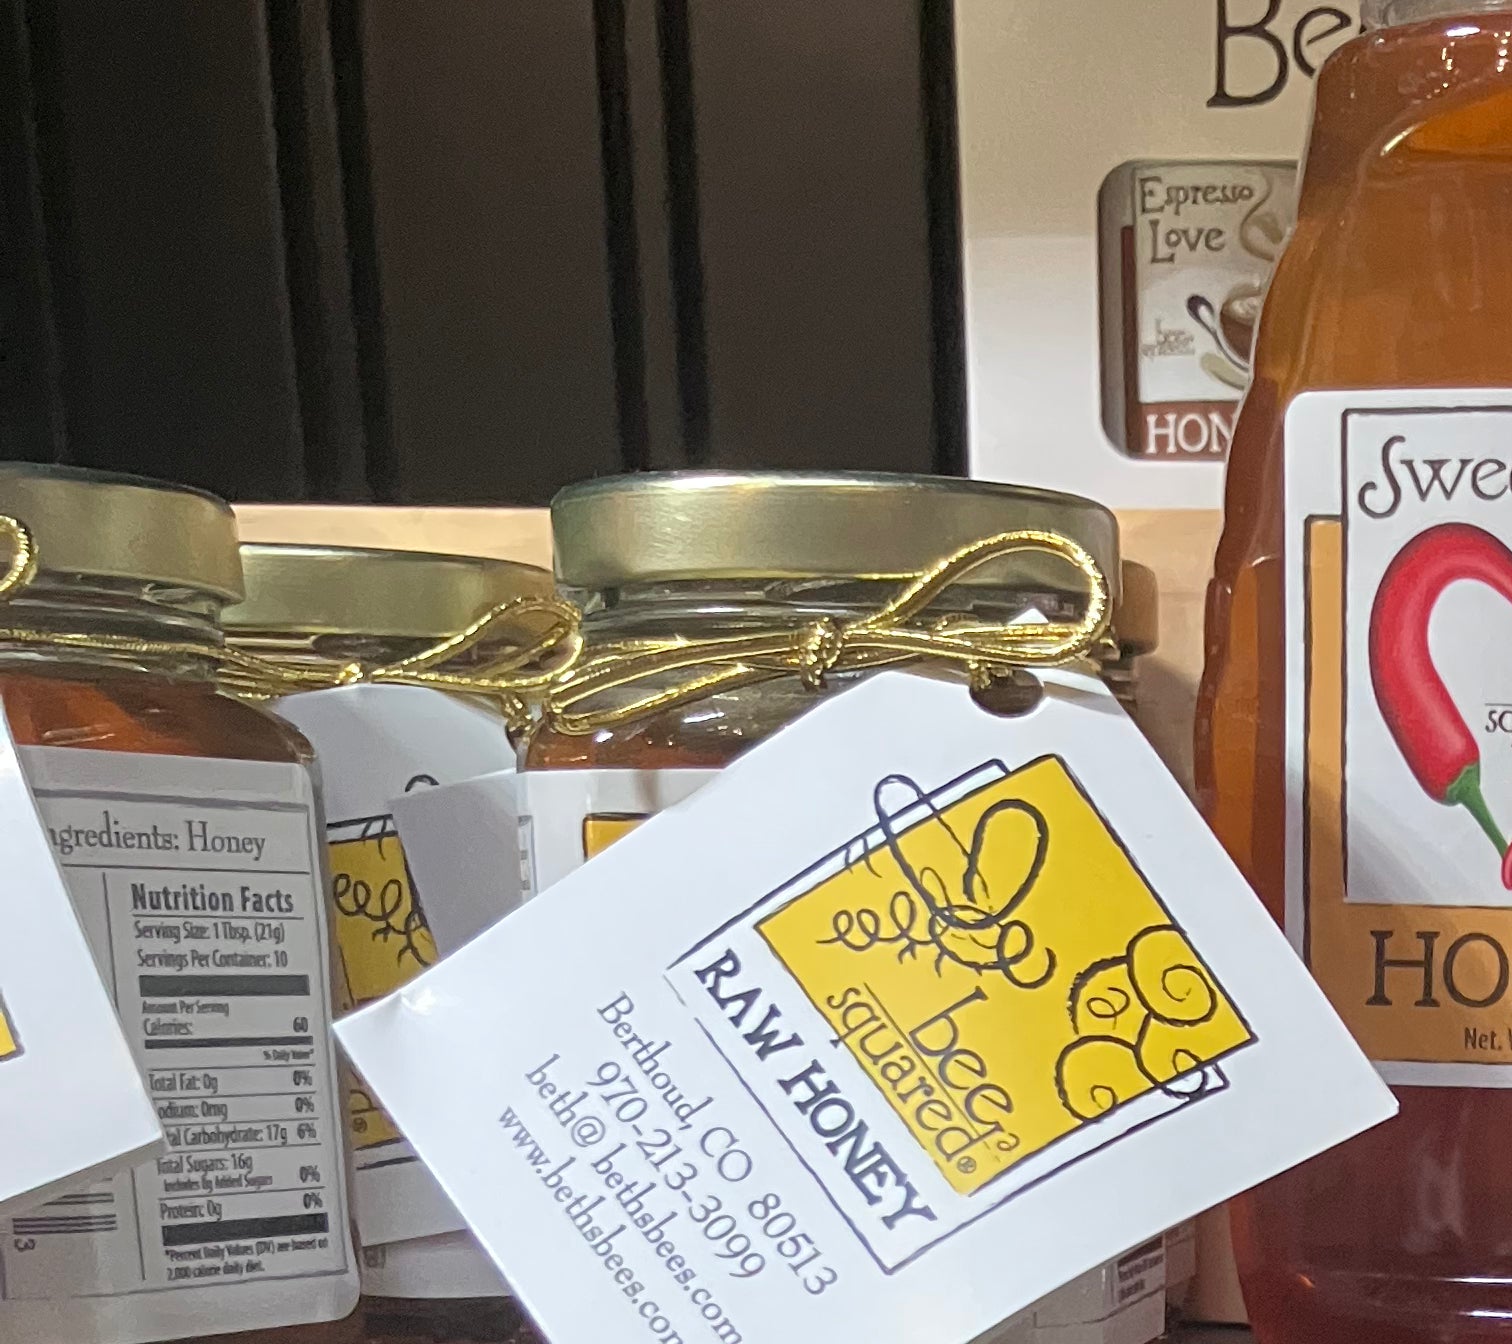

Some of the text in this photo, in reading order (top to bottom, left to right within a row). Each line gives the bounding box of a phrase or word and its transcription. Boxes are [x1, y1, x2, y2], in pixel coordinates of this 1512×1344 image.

[1139, 176, 1256, 216] Espresso
[1150, 219, 1226, 264] Love
[1146, 412, 1236, 455] HON
[49, 810, 266, 861] ngredients: Honey
[131, 883, 294, 913] Nutrition Facts
[135, 921, 180, 943] Serving
[254, 923, 285, 944] (21g)
[137, 949, 188, 971] Servings
[191, 950, 209, 967] Per
[274, 951, 288, 967] 10
[909, 986, 1014, 1125] bee
[293, 1070, 313, 1086] 0%
[694, 948, 938, 1231] RAW HONEY
[158, 1101, 199, 1119] odium:
[295, 1096, 314, 1113] 0%
[266, 1124, 287, 1146] 17g
[297, 1123, 316, 1140] 6%
[597, 991, 838, 1296] Berthoud, CO 80513
[300, 1166, 320, 1183] 0%
[586, 1061, 766, 1278] 970-213-3099
[303, 1193, 323, 1210] 0%
